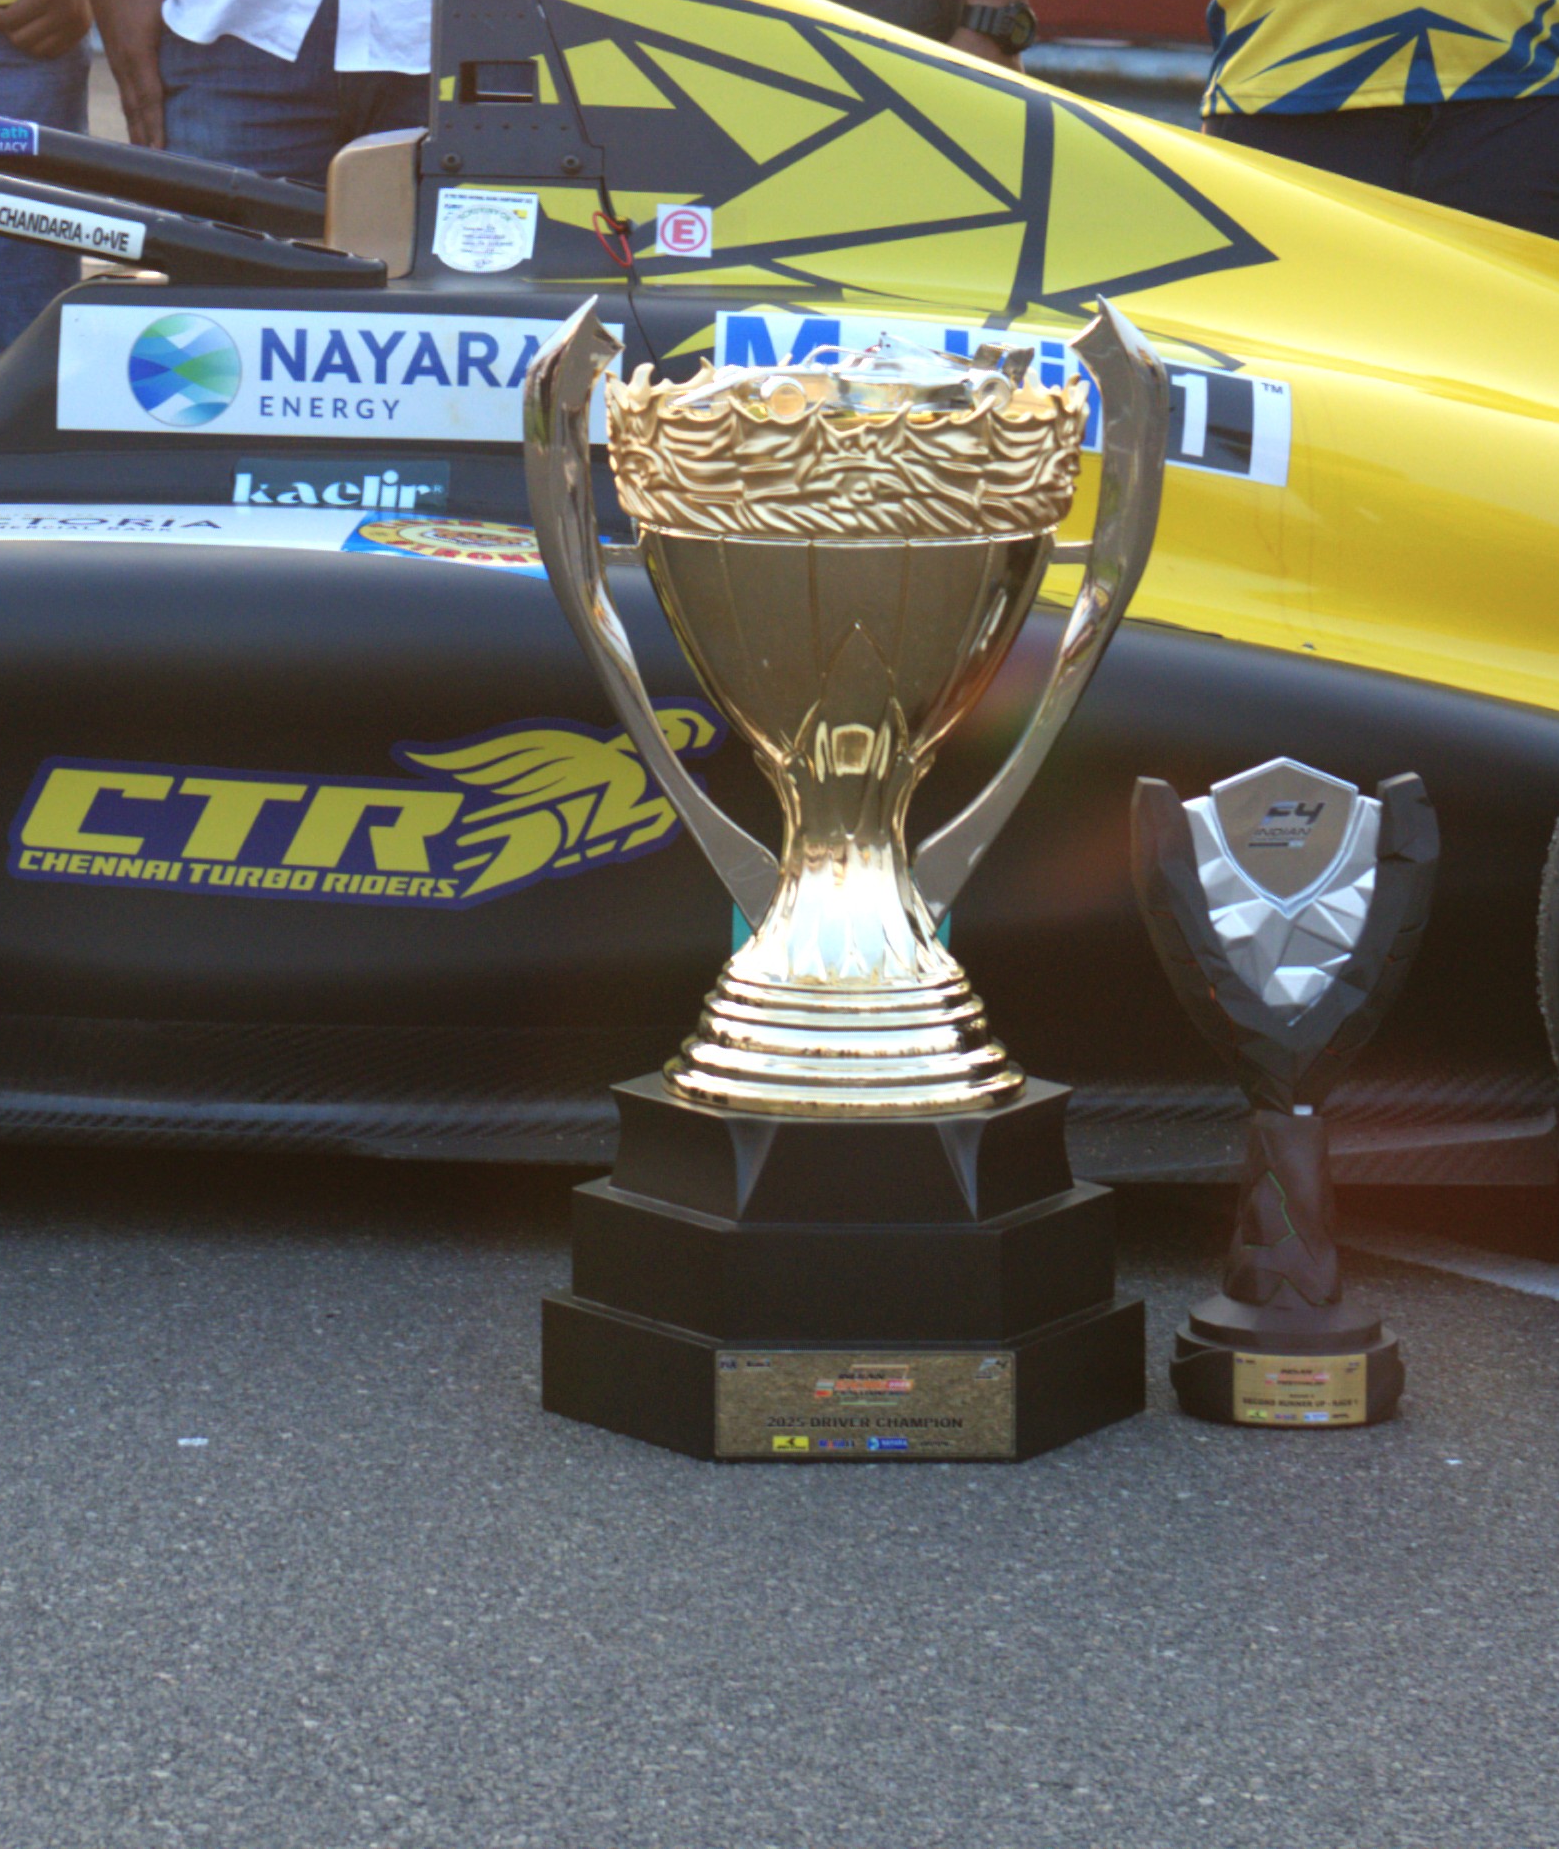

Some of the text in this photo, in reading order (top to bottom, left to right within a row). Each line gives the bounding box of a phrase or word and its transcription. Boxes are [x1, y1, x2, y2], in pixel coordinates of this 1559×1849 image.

[671, 218, 699, 246] E
[261, 397, 401, 420] ENERGY
[21, 768, 464, 872] CTR
[1259, 800, 1326, 826] F4
[18, 849, 460, 900] CHENNAI TURBO RIDERS
[767, 1416, 964, 1429] 2025 DRIVER CHAMPION
